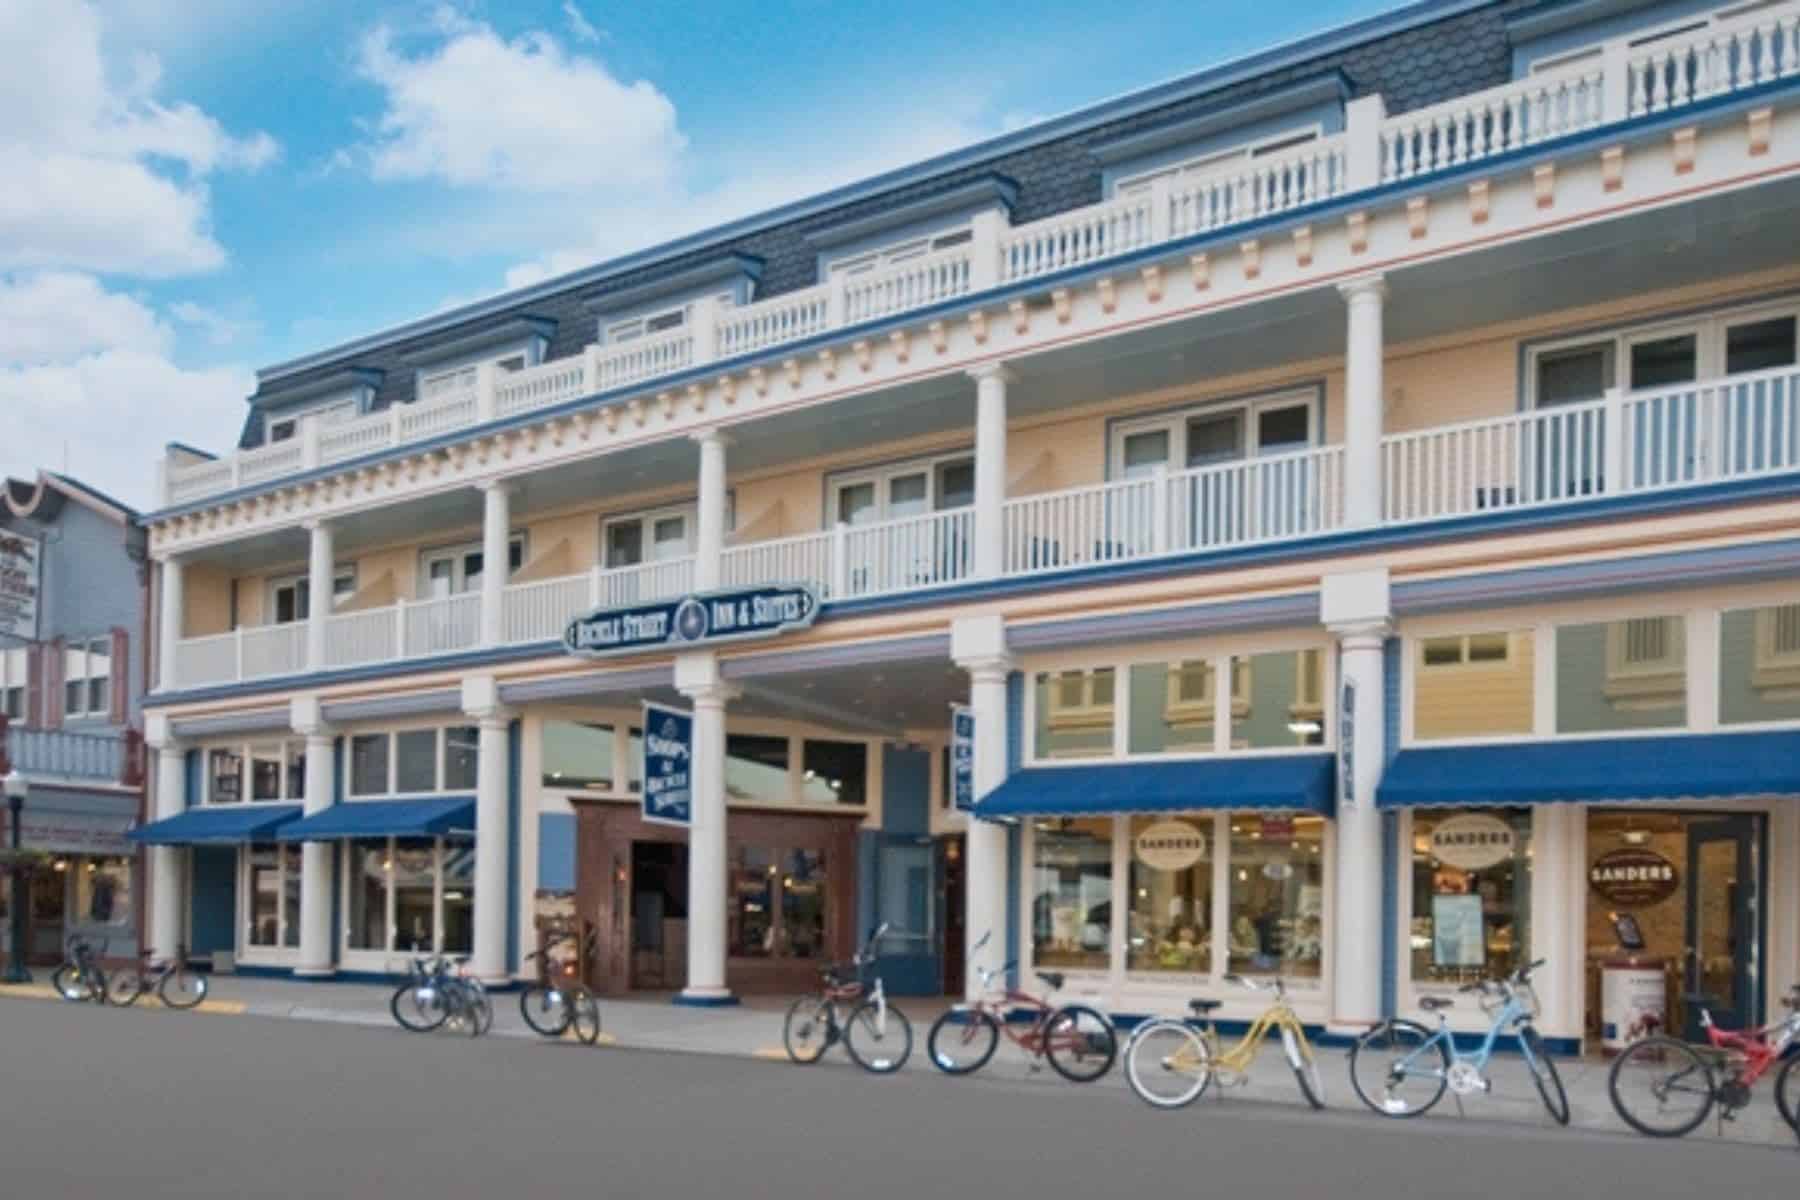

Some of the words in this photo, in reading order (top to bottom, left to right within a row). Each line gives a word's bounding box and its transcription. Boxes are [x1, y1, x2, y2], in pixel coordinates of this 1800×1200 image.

[738, 599, 750, 626] &
[1139, 838, 1201, 850] SANDERS
[1434, 831, 1511, 847] SANDERS
[1591, 865, 1673, 882] SANDERS
